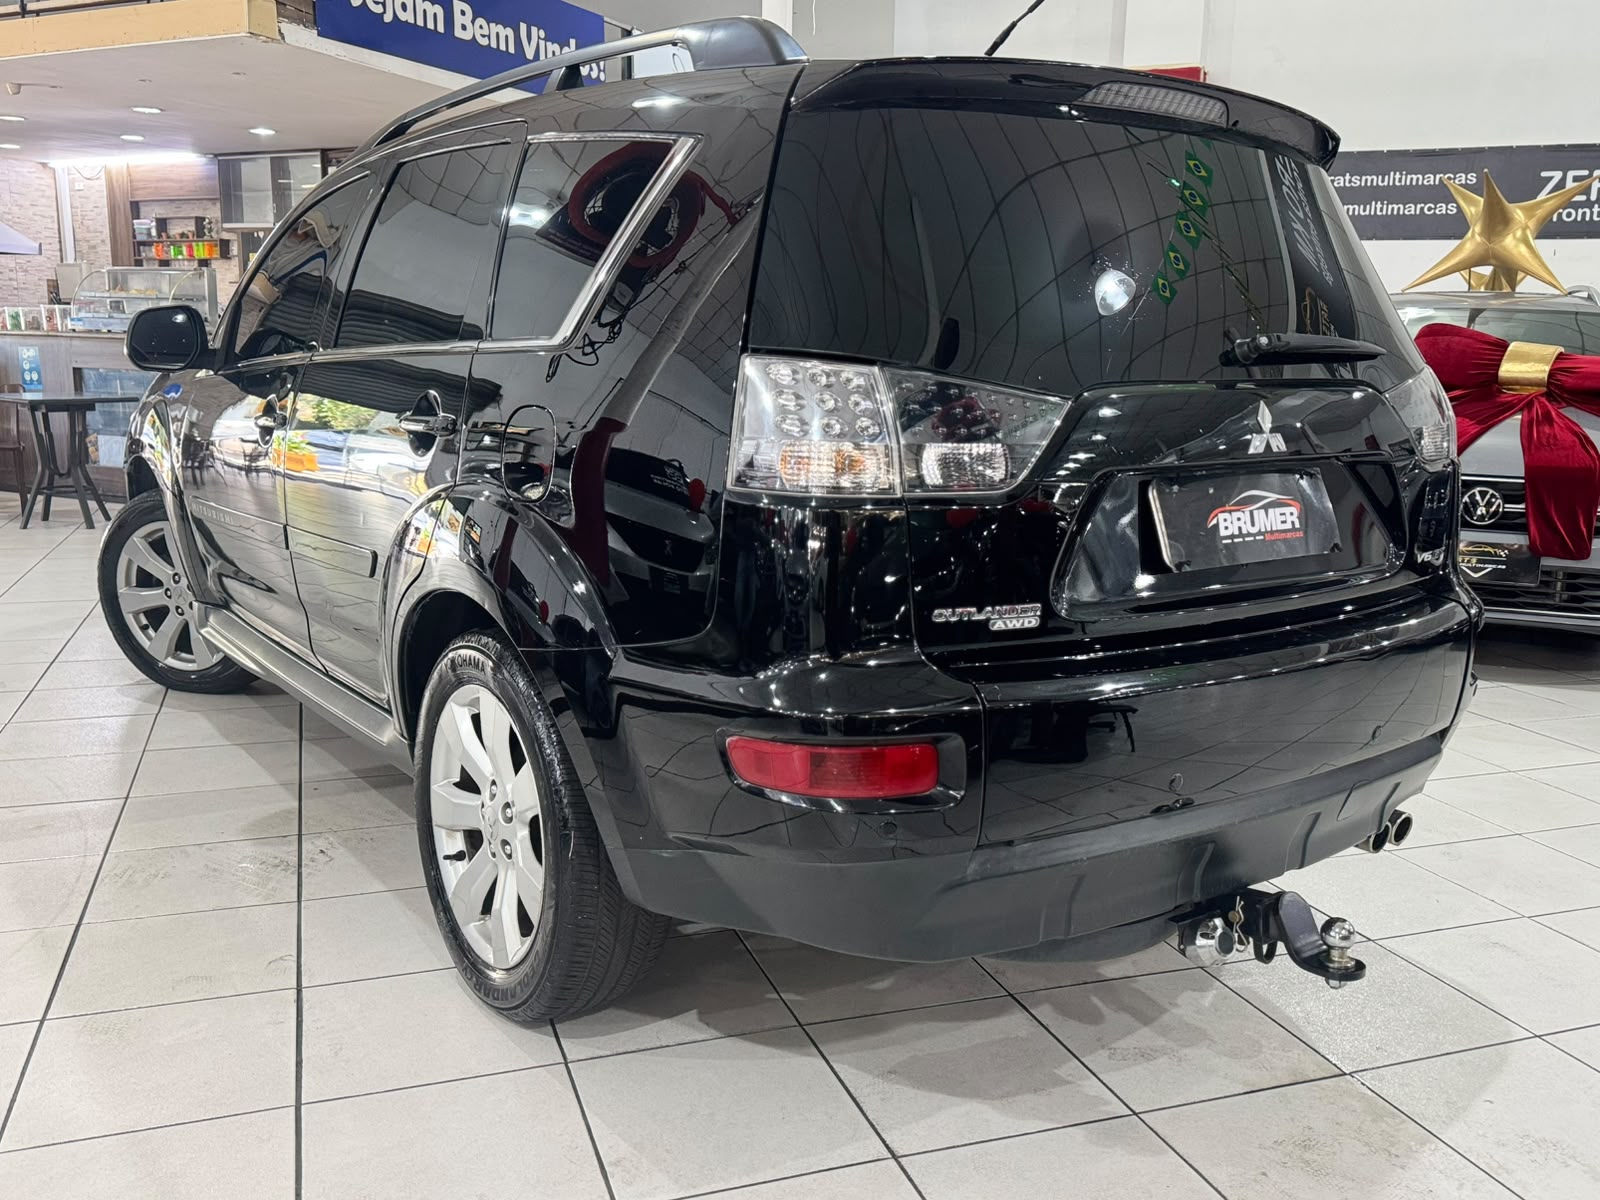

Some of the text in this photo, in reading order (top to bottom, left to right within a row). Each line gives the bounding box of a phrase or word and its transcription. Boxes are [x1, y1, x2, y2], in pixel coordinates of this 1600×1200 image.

[350, 0, 445, 34] ejam
[453, 1, 515, 54] Bem
[191, 502, 234, 526] MITSUBISHI
[1218, 506, 1301, 536] BRUMER
[1264, 531, 1304, 541] Multimarcas
[931, 603, 1042, 622] OUTLANDER
[991, 617, 1038, 630] AWD
